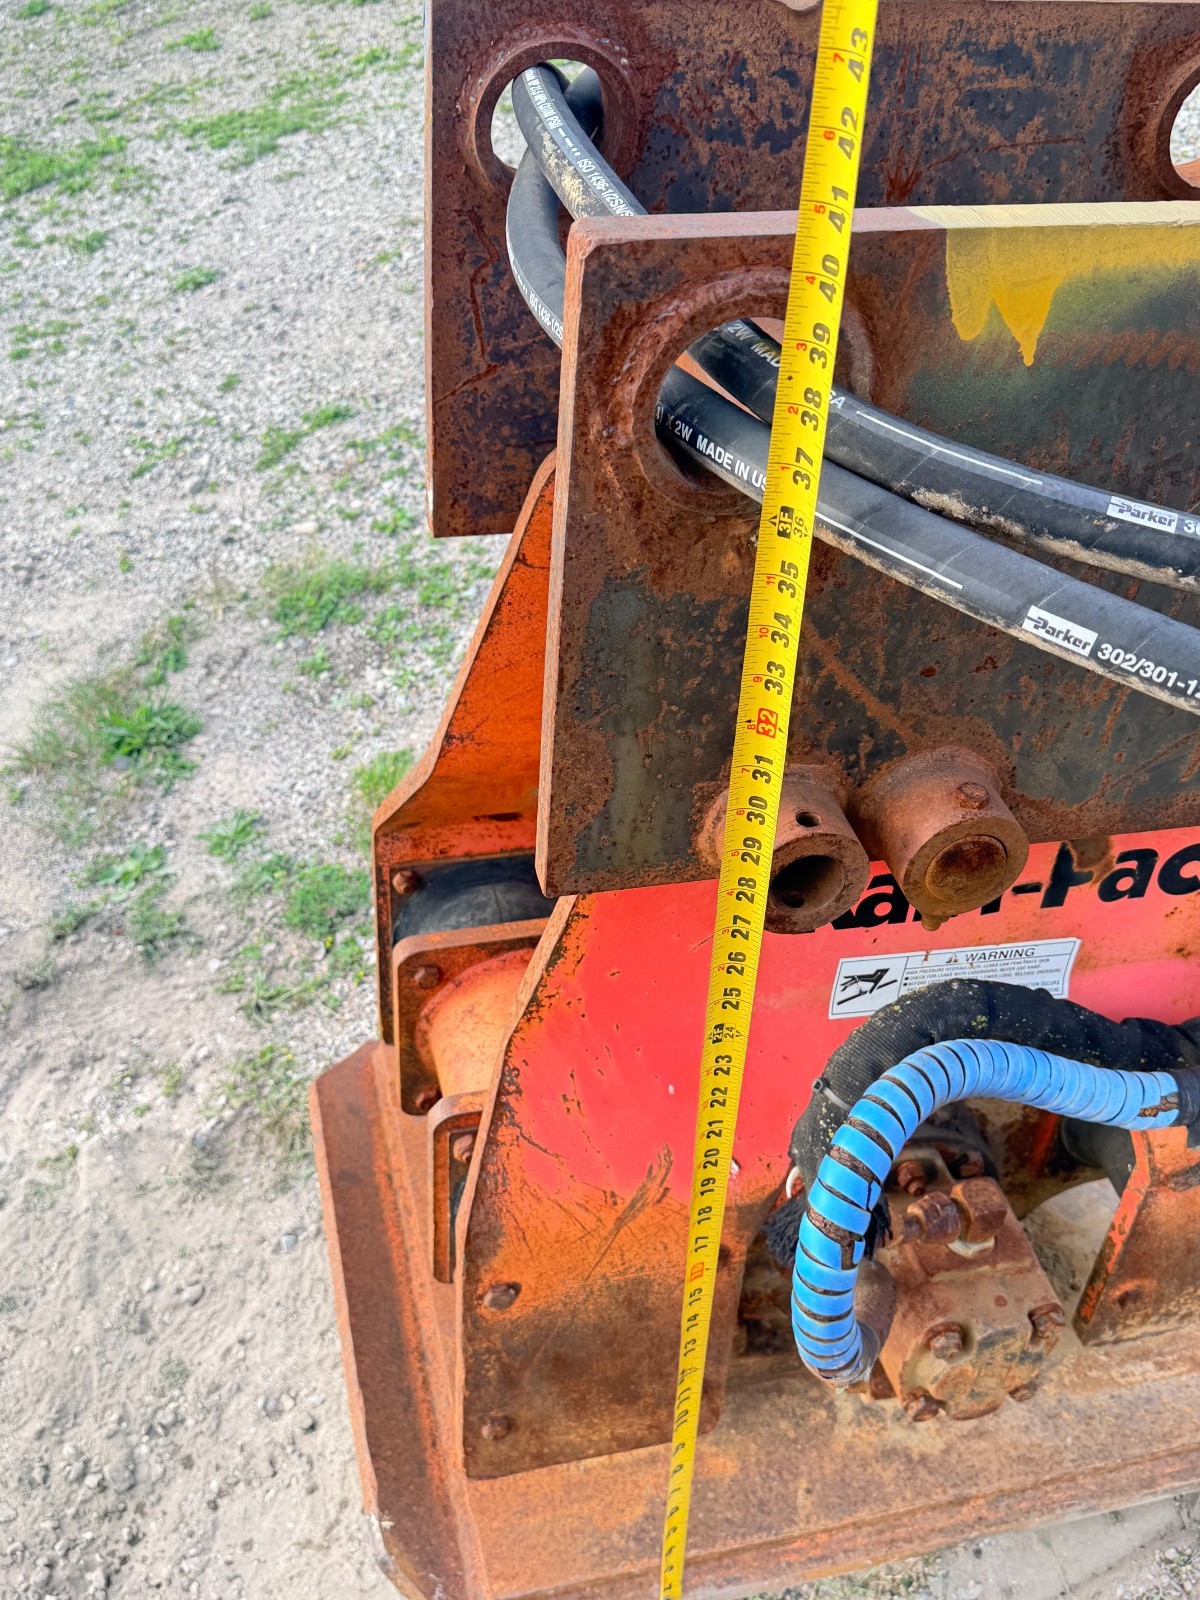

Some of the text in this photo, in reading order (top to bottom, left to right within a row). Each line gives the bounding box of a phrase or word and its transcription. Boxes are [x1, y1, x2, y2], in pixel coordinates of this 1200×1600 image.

[833, 53, 845, 63] 7
[848, 28, 868, 83] 43
[824, 130, 835, 140] 6
[838, 107, 859, 160] 42
[576, 158, 596, 172] ISO
[815, 205, 826, 214] 5
[828, 186, 848, 233] 41
[805, 276, 816, 285] 4
[819, 254, 839, 303] 40
[727, 323, 752, 341] 2W
[796, 343, 807, 351] 3
[809, 322, 830, 369] 39
[788, 406, 799, 415] 2
[801, 388, 822, 431] 38
[674, 420, 693, 442] 2W
[696, 434, 734, 471] MADE
[734, 459, 751, 481] IN
[793, 447, 814, 490] 37
[778, 512, 792, 533] 3F
[1109, 502, 1175, 527] Parker
[793, 516, 804, 538] 36
[766, 575, 776, 585] 11
[778, 560, 799, 598] 35
[759, 627, 769, 638] 10
[771, 612, 792, 648] 34
[1026, 615, 1091, 651] Parker
[764, 661, 785, 695] 33
[758, 710, 777, 736] 32
[752, 755, 773, 784] 31
[746, 796, 768, 825] 30
[741, 837, 762, 866] 29
[736, 877, 757, 904] 28
[731, 915, 751, 941] 27
[726, 952, 746, 976] 26
[965, 947, 1035, 962] WARNING
[721, 987, 742, 1010] 25
[724, 1026, 735, 1039] 24
[714, 1055, 732, 1076] 23
[710, 1087, 728, 1108] 22
[706, 1120, 724, 1139] 21
[703, 1148, 720, 1169] 20
[700, 1177, 716, 1196] 19
[697, 1206, 712, 1225] 18
[694, 1236, 709, 1253] 17
[689, 1288, 703, 1306] 15
[686, 1313, 700, 1332] 14
[684, 1338, 697, 1357] 13
[675, 1409, 689, 1432] 10
